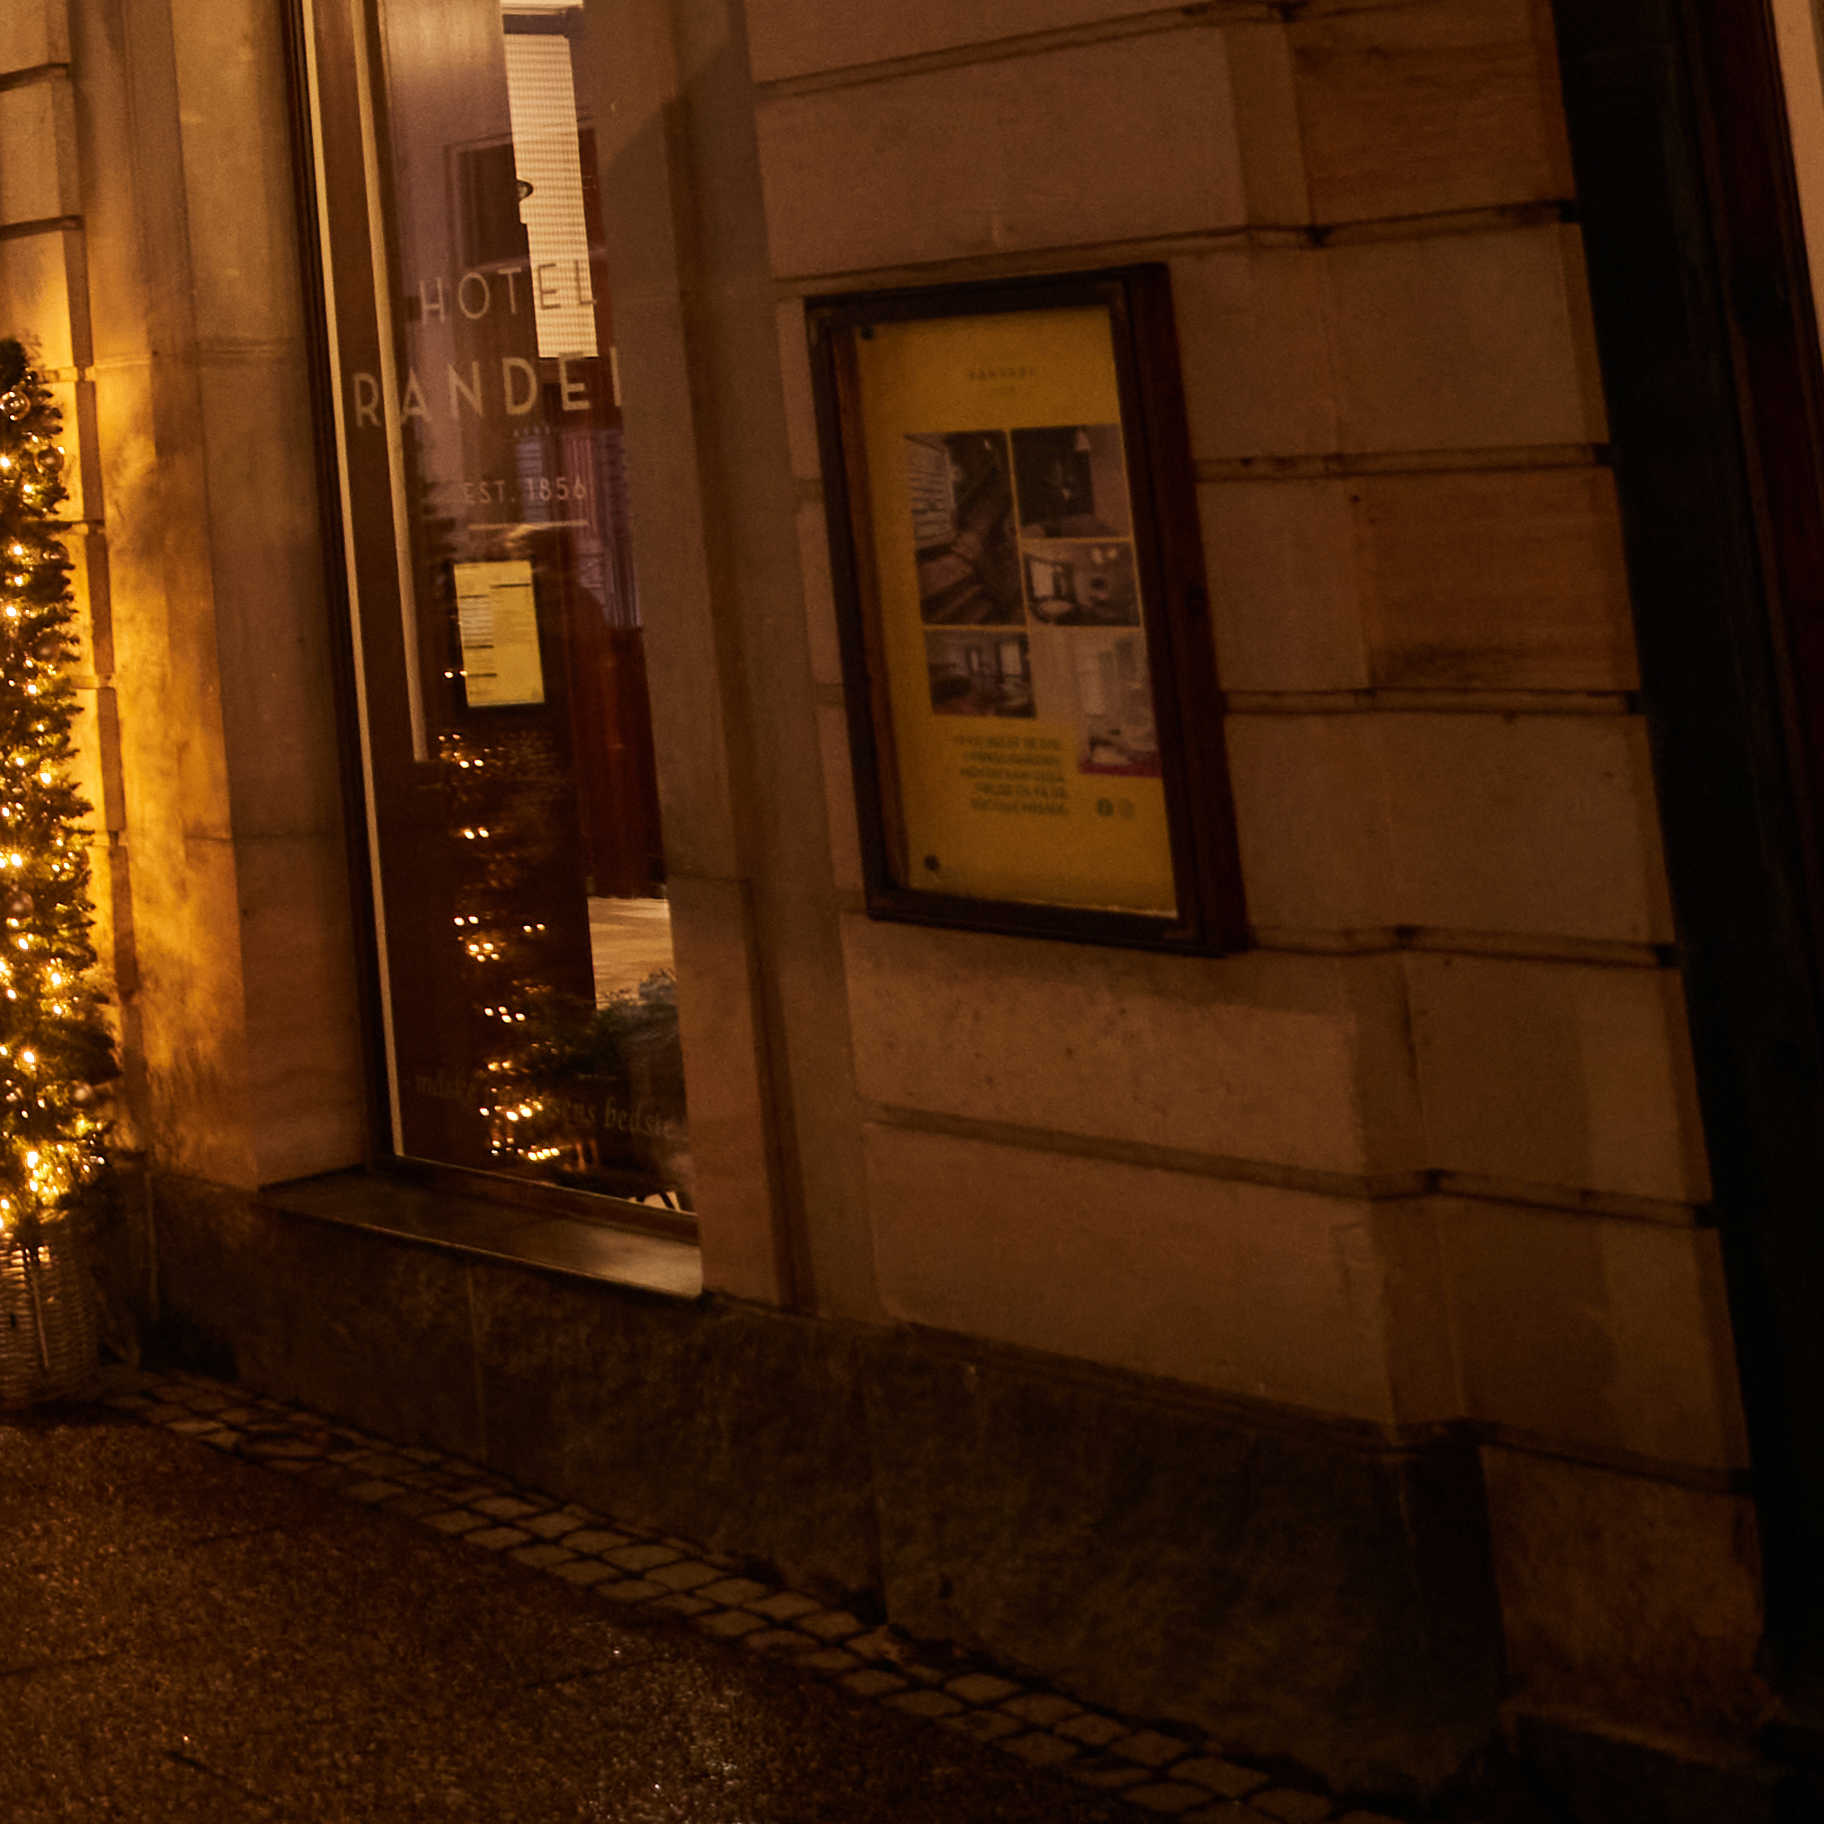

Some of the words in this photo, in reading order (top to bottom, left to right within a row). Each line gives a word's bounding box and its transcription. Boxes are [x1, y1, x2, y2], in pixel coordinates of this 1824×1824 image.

[418, 258, 598, 326] HOTEL
[463, 479, 516, 504] EST.
[525, 475, 587, 502] 1856
